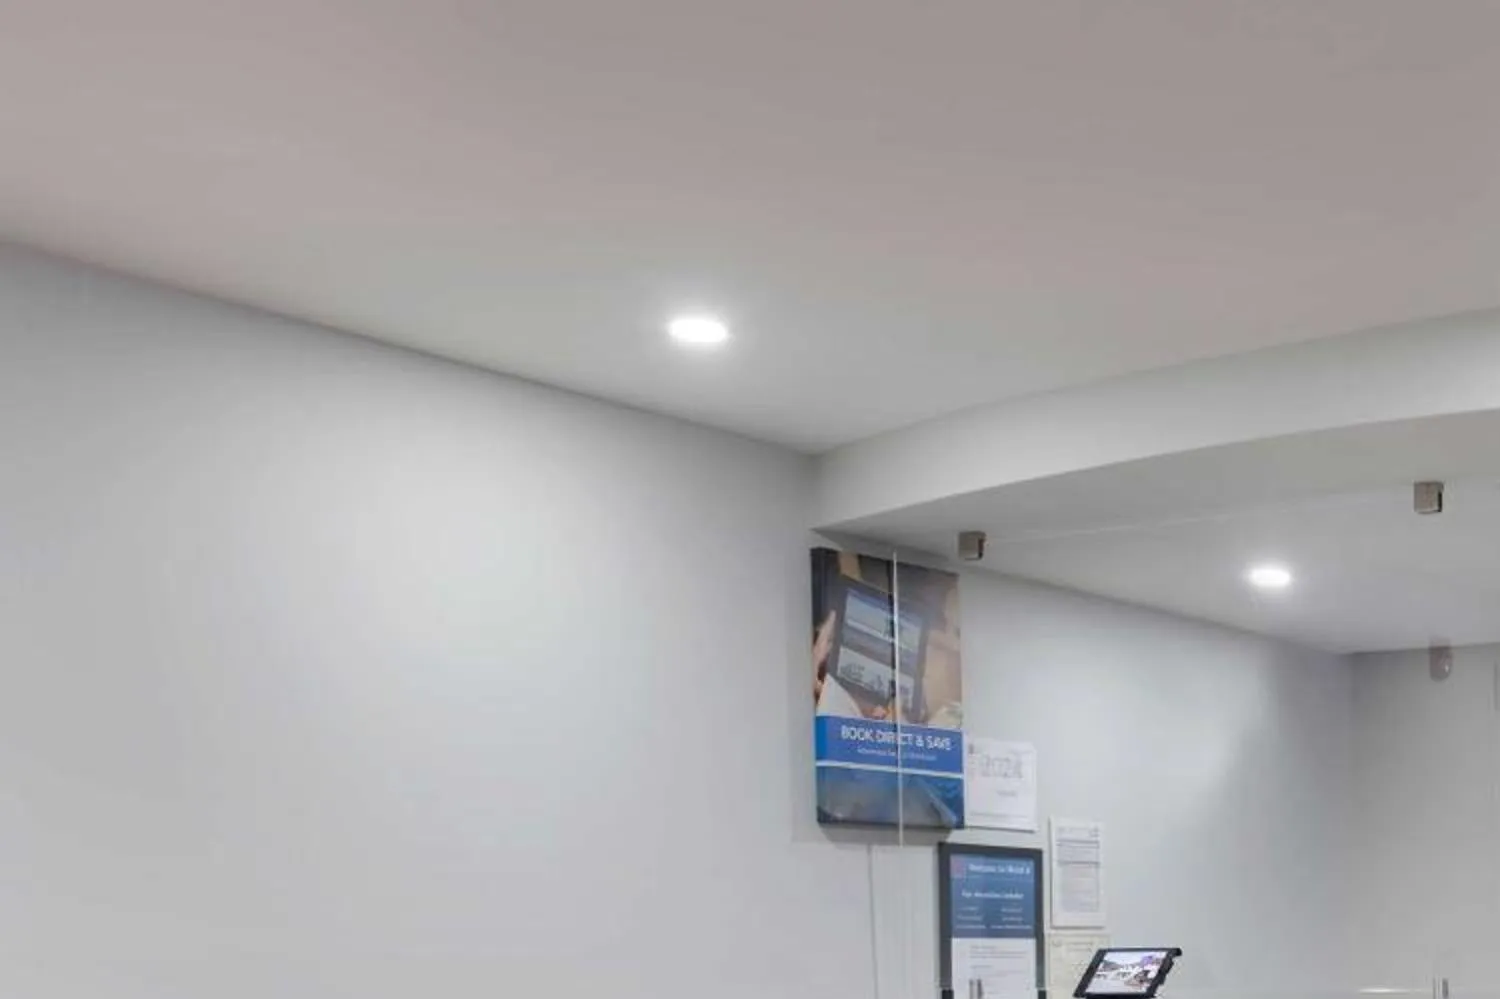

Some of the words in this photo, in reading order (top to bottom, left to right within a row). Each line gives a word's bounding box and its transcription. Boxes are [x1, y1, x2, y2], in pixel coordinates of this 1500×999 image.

[841, 724, 873, 742] BOOK
[875, 729, 913, 745] DIRCT
[926, 735, 951, 751] SAVE
